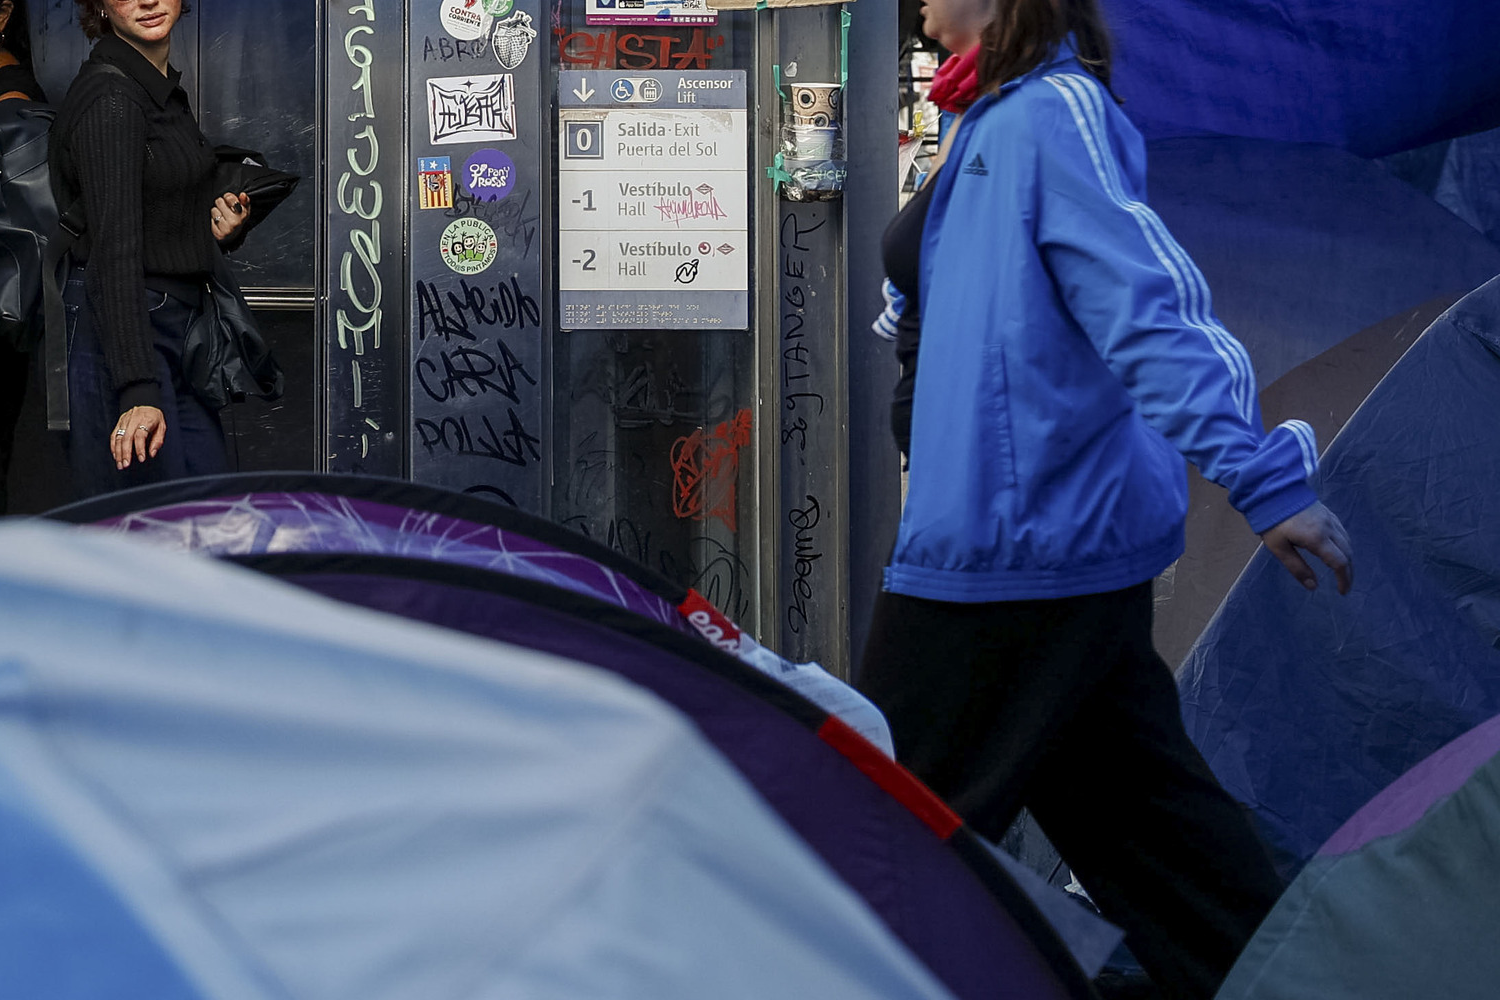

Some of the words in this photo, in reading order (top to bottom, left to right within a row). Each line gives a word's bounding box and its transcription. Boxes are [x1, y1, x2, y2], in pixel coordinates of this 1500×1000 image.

[448, 12, 482, 28] CORRIENTE
[450, 6, 482, 21] CONTRA
[677, 77, 733, 89] Ascensor
[677, 91, 696, 104] Lift
[576, 128, 592, 152] 0
[618, 122, 666, 137] Salida
[674, 122, 700, 137] Exit
[618, 142, 663, 157] Puerta
[668, 142, 691, 157] del
[695, 142, 718, 157] Sol
[572, 189, 597, 212] -1
[619, 182, 692, 197] Vestíbulo
[618, 202, 647, 216] Hall
[449, 224, 460, 235] LA
[572, 249, 597, 271] -2
[619, 242, 692, 256] Vestíbulo
[618, 262, 647, 276] Hall
[416, 339, 537, 405] CARA
